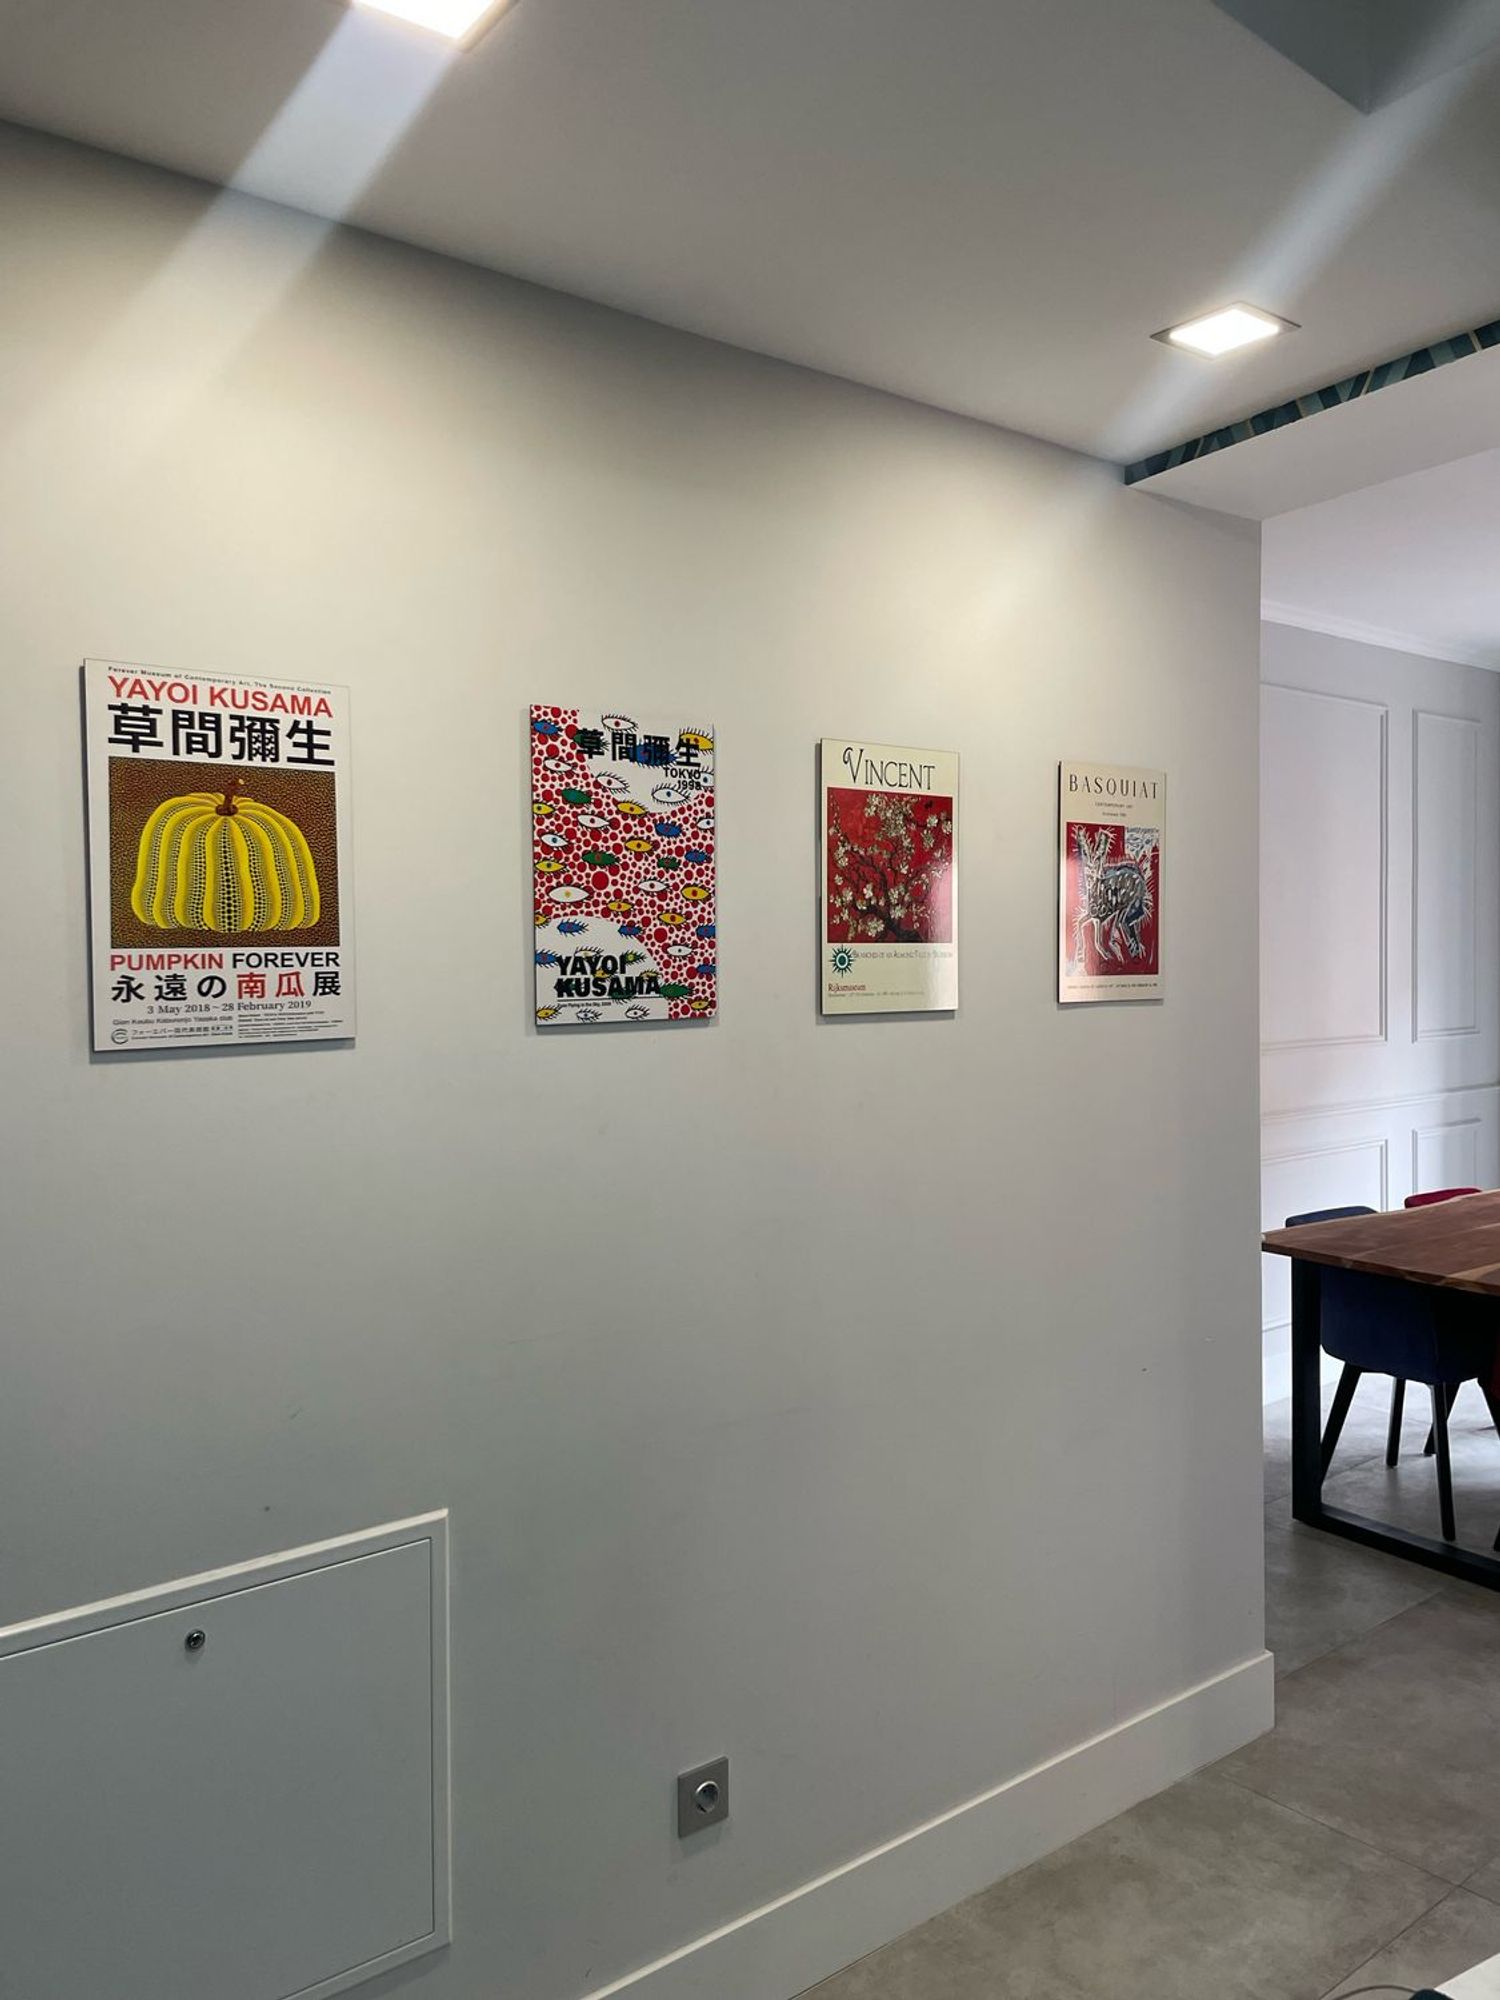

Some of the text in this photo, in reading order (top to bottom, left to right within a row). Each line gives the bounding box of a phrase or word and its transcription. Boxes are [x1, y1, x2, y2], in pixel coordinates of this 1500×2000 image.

[108, 675, 333, 718] YAYOI KUSAMA
[107, 703, 335, 766] 草間彌生
[664, 767, 701, 780] TOKYO
[110, 952, 340, 971] PUMPKIN FOREVER
[556, 955, 627, 976] YAYOI
[111, 971, 342, 1004] 永遠の南瓜展
[556, 976, 661, 998] KUSAMA
[147, 1005, 154, 1015] 3
[158, 1004, 181, 1016] May
[184, 1003, 211, 1013] 2018
[221, 1003, 235, 1012] 28
[237, 1002, 285, 1012] February
[288, 1000, 312, 1009] 2019
